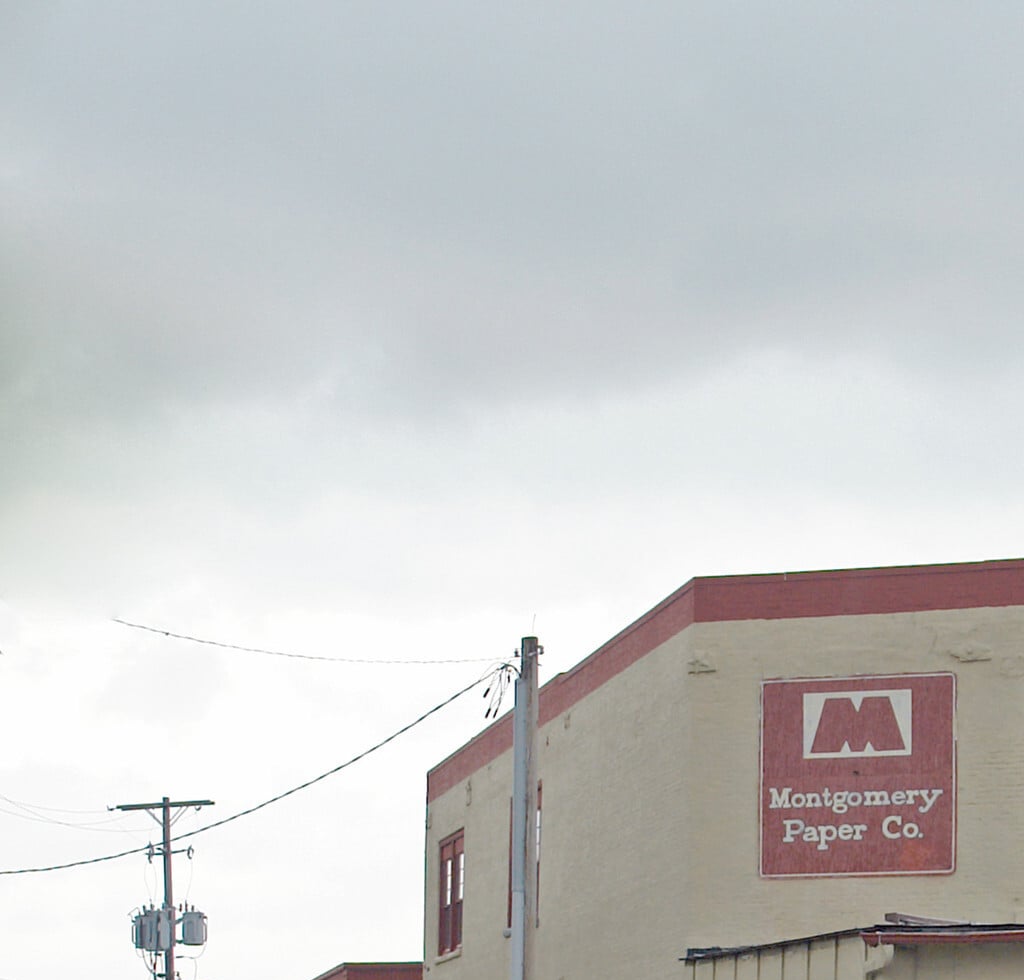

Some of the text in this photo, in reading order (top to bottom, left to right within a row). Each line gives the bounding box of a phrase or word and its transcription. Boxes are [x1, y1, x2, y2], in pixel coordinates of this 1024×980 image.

[769, 788, 943, 813] Montgomery
[783, 816, 924, 850] Paper Co.
